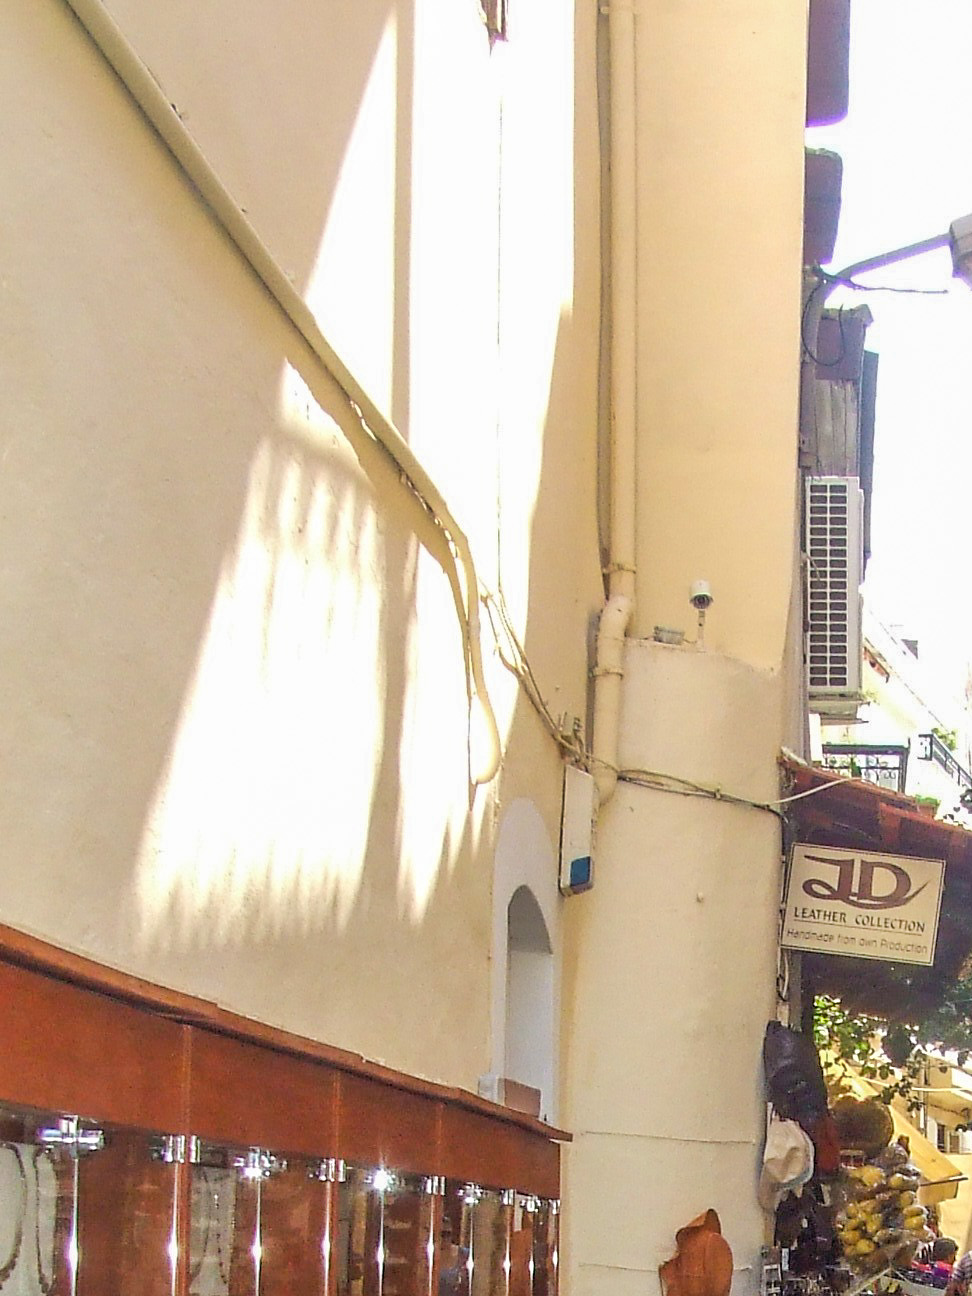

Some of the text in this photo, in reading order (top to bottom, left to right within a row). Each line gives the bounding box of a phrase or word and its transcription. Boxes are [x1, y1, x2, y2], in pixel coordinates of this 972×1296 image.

[794, 907, 926, 933] LEATHER COLLECTION
[787, 928, 928, 954] Handmade from own Production
